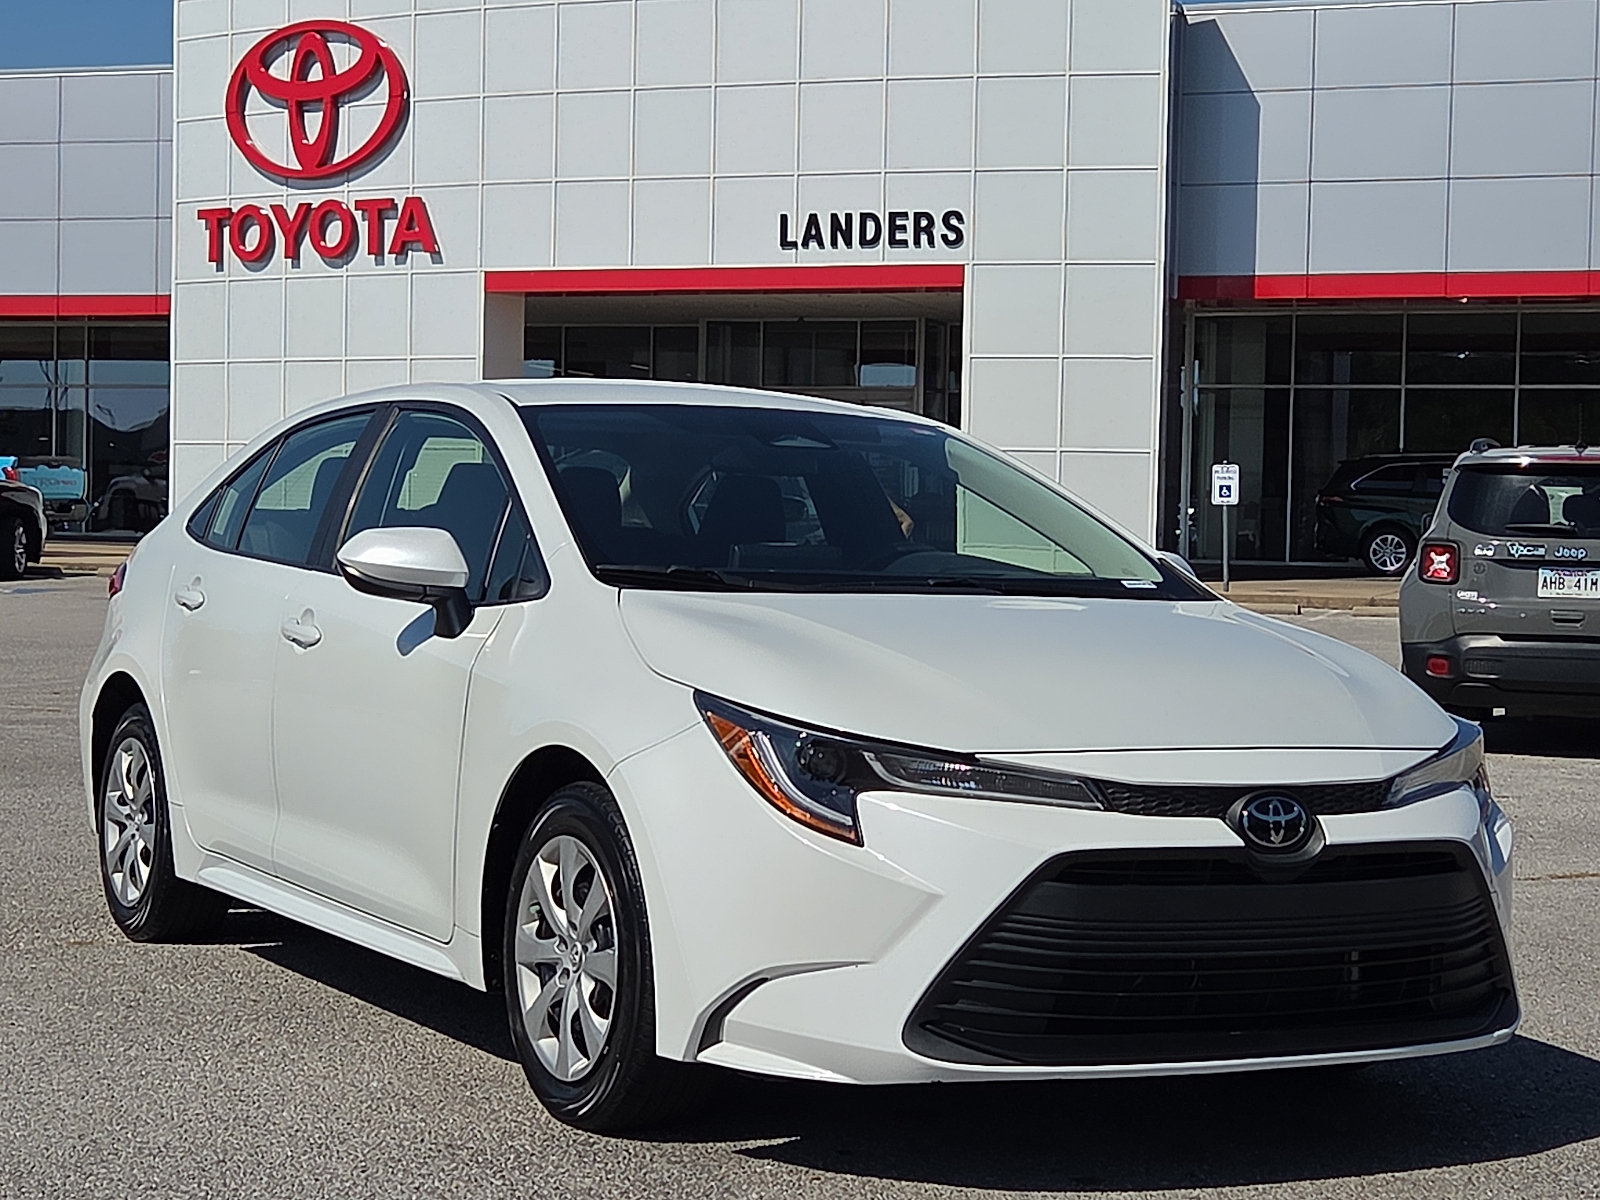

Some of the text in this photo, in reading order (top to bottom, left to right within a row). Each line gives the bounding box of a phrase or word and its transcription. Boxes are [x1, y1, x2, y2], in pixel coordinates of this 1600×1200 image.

[197, 196, 439, 264] TOYOTA
[779, 210, 965, 250] LANDERS
[1541, 575, 1566, 591] AHB
